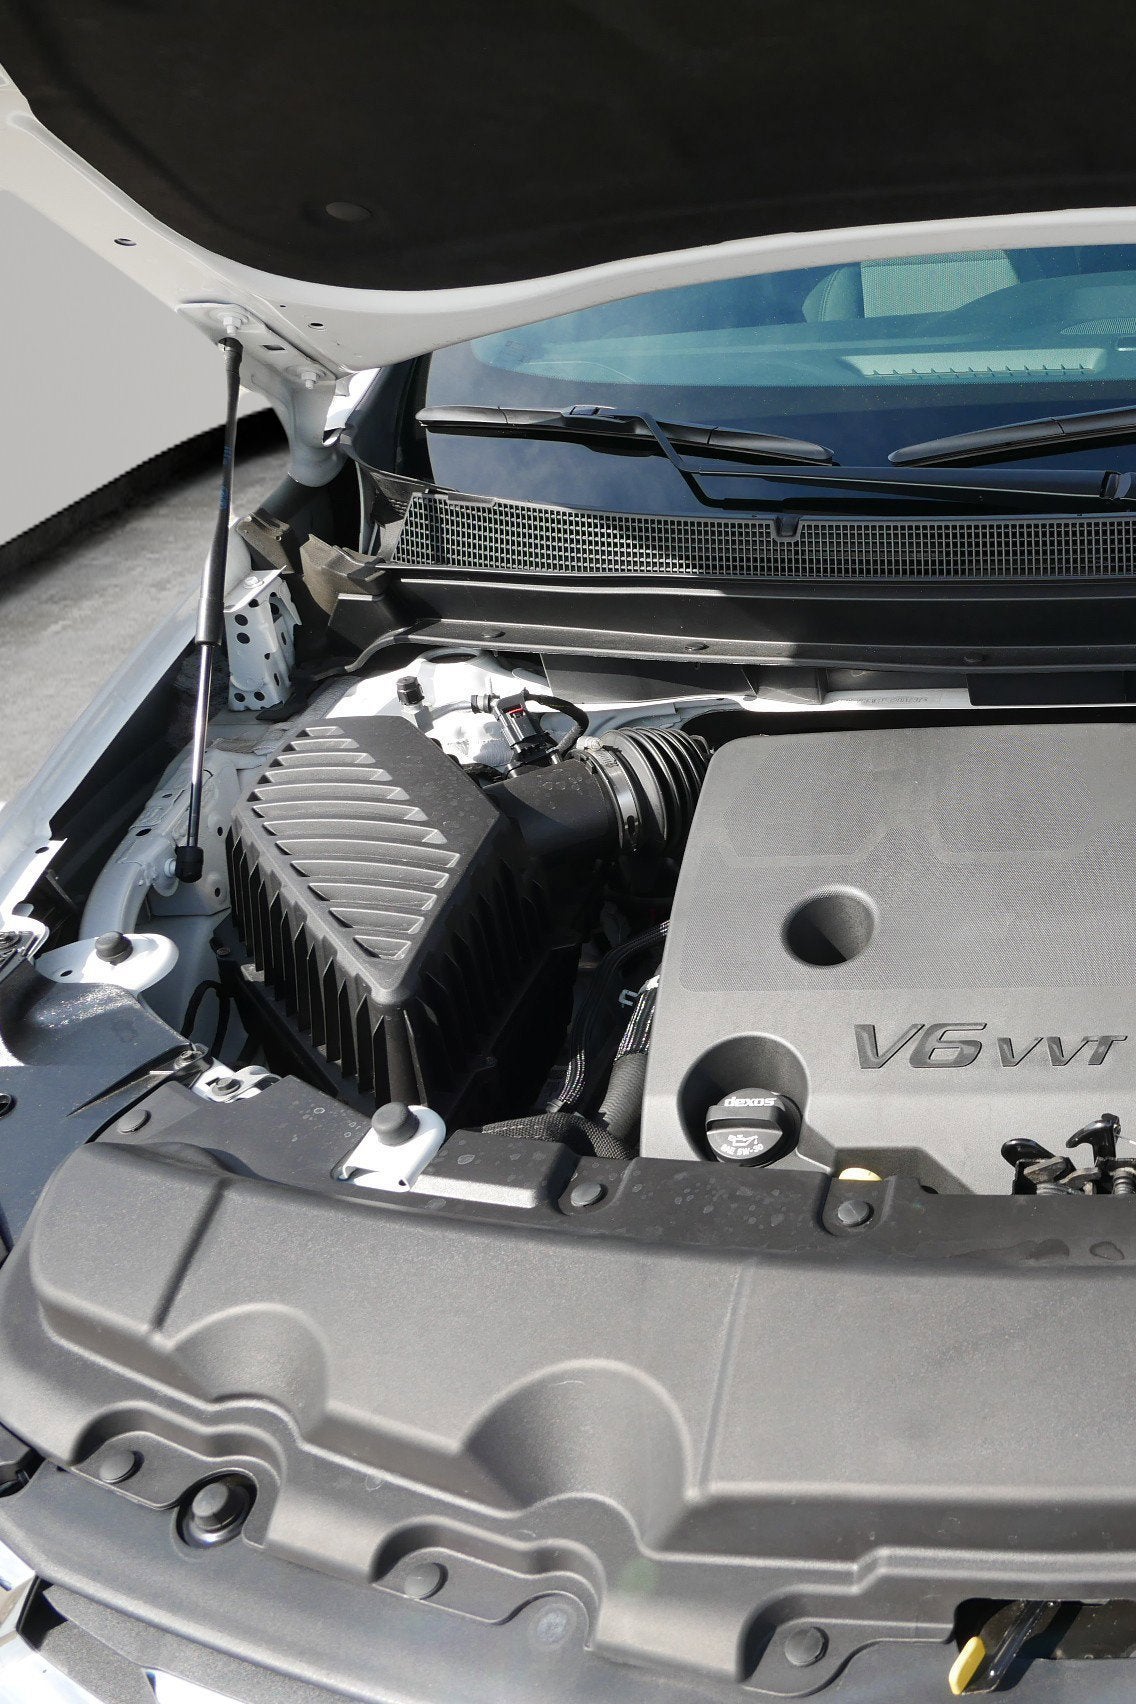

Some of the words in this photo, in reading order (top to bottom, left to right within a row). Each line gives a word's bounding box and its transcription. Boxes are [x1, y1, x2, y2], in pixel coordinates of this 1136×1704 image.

[853, 1022, 987, 1070] V6
[996, 1034, 1128, 1067] VVT
[724, 1096, 777, 1107] dexos
